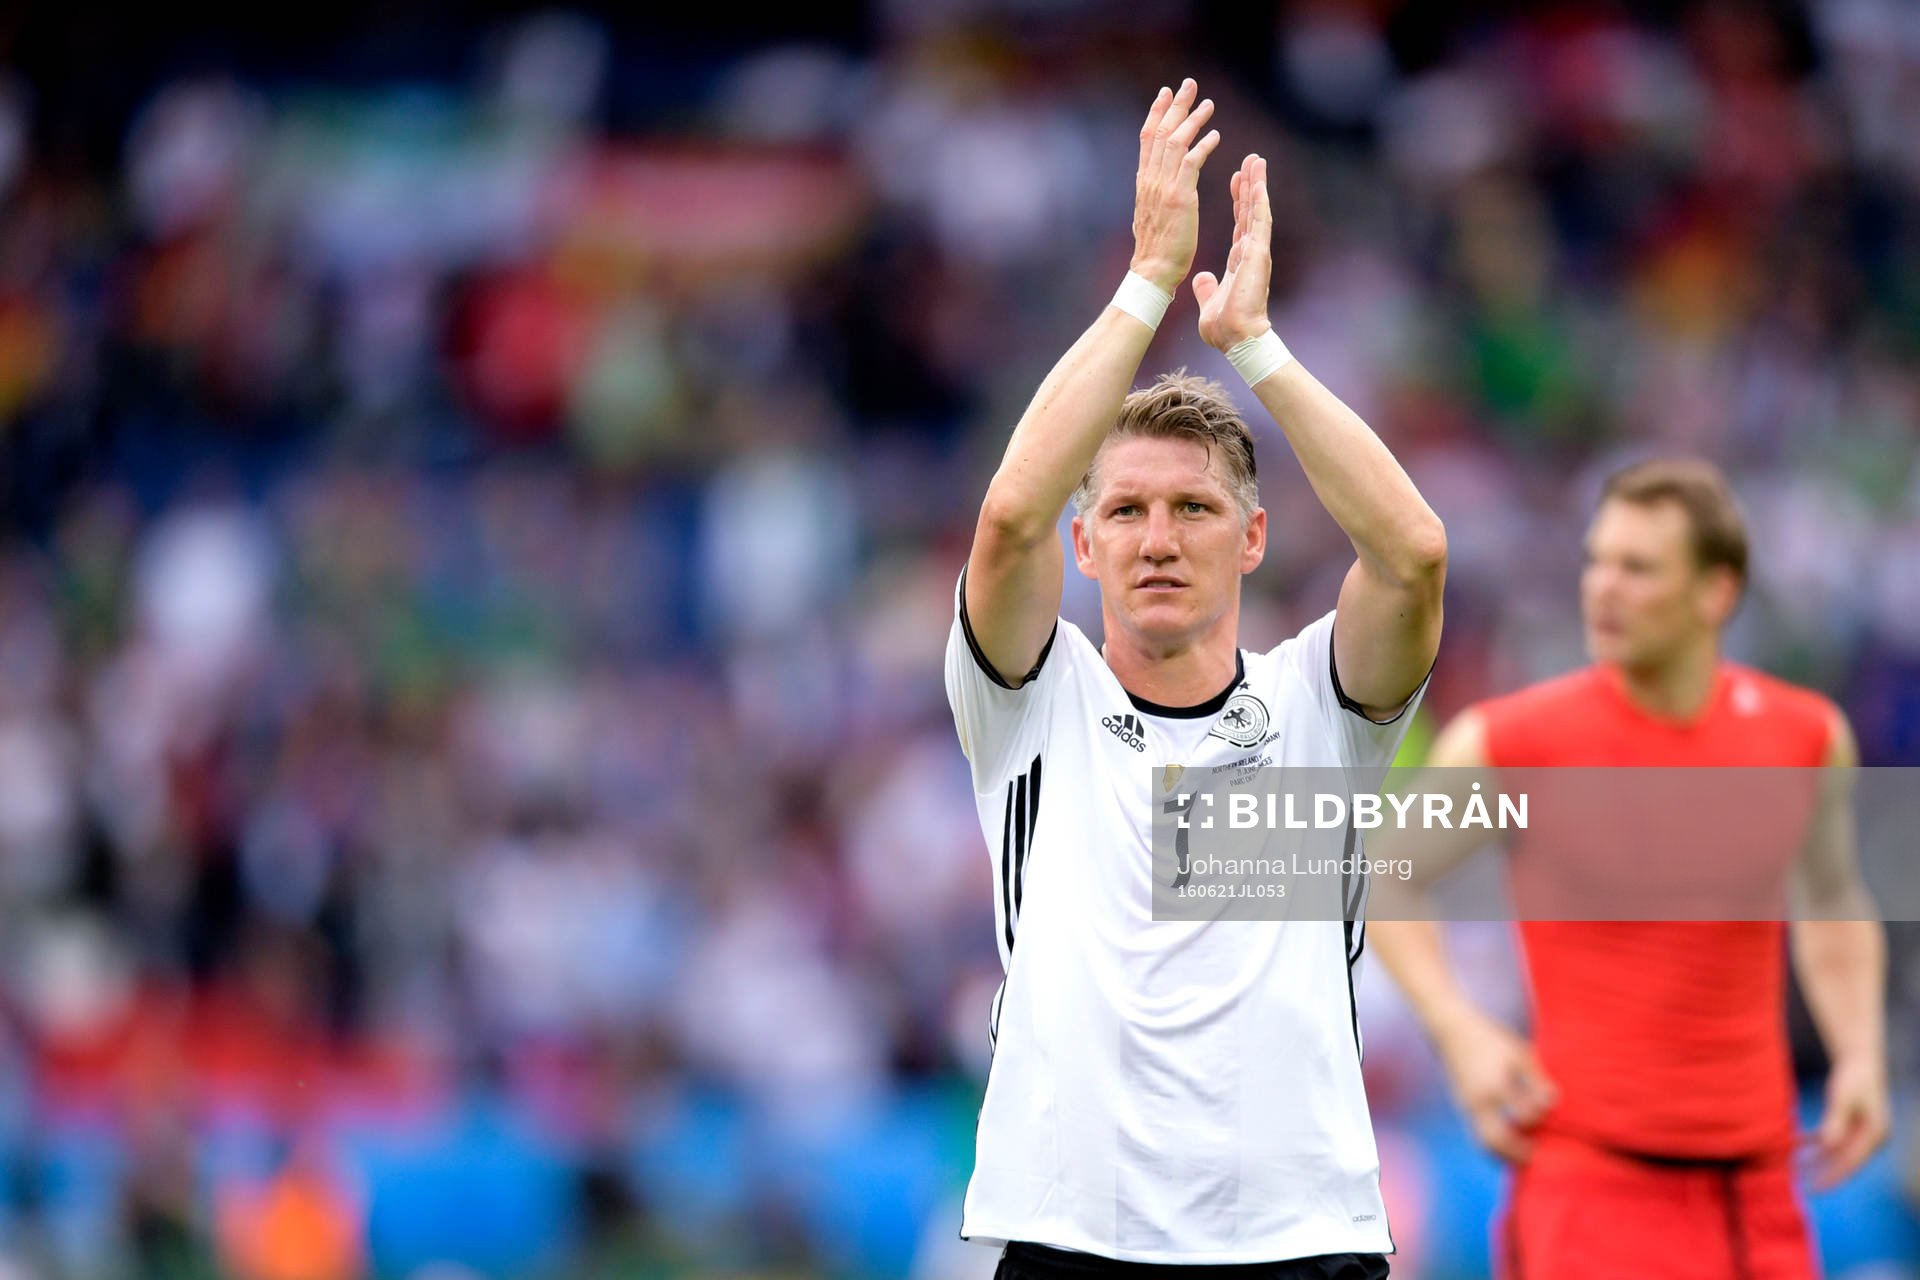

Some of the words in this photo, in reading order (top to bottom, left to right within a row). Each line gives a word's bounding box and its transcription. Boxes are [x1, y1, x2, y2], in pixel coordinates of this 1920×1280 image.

[1101, 716, 1146, 753] adidas
[1237, 755, 1259, 768] IRELAND
[1229, 777, 1245, 787] PARC
